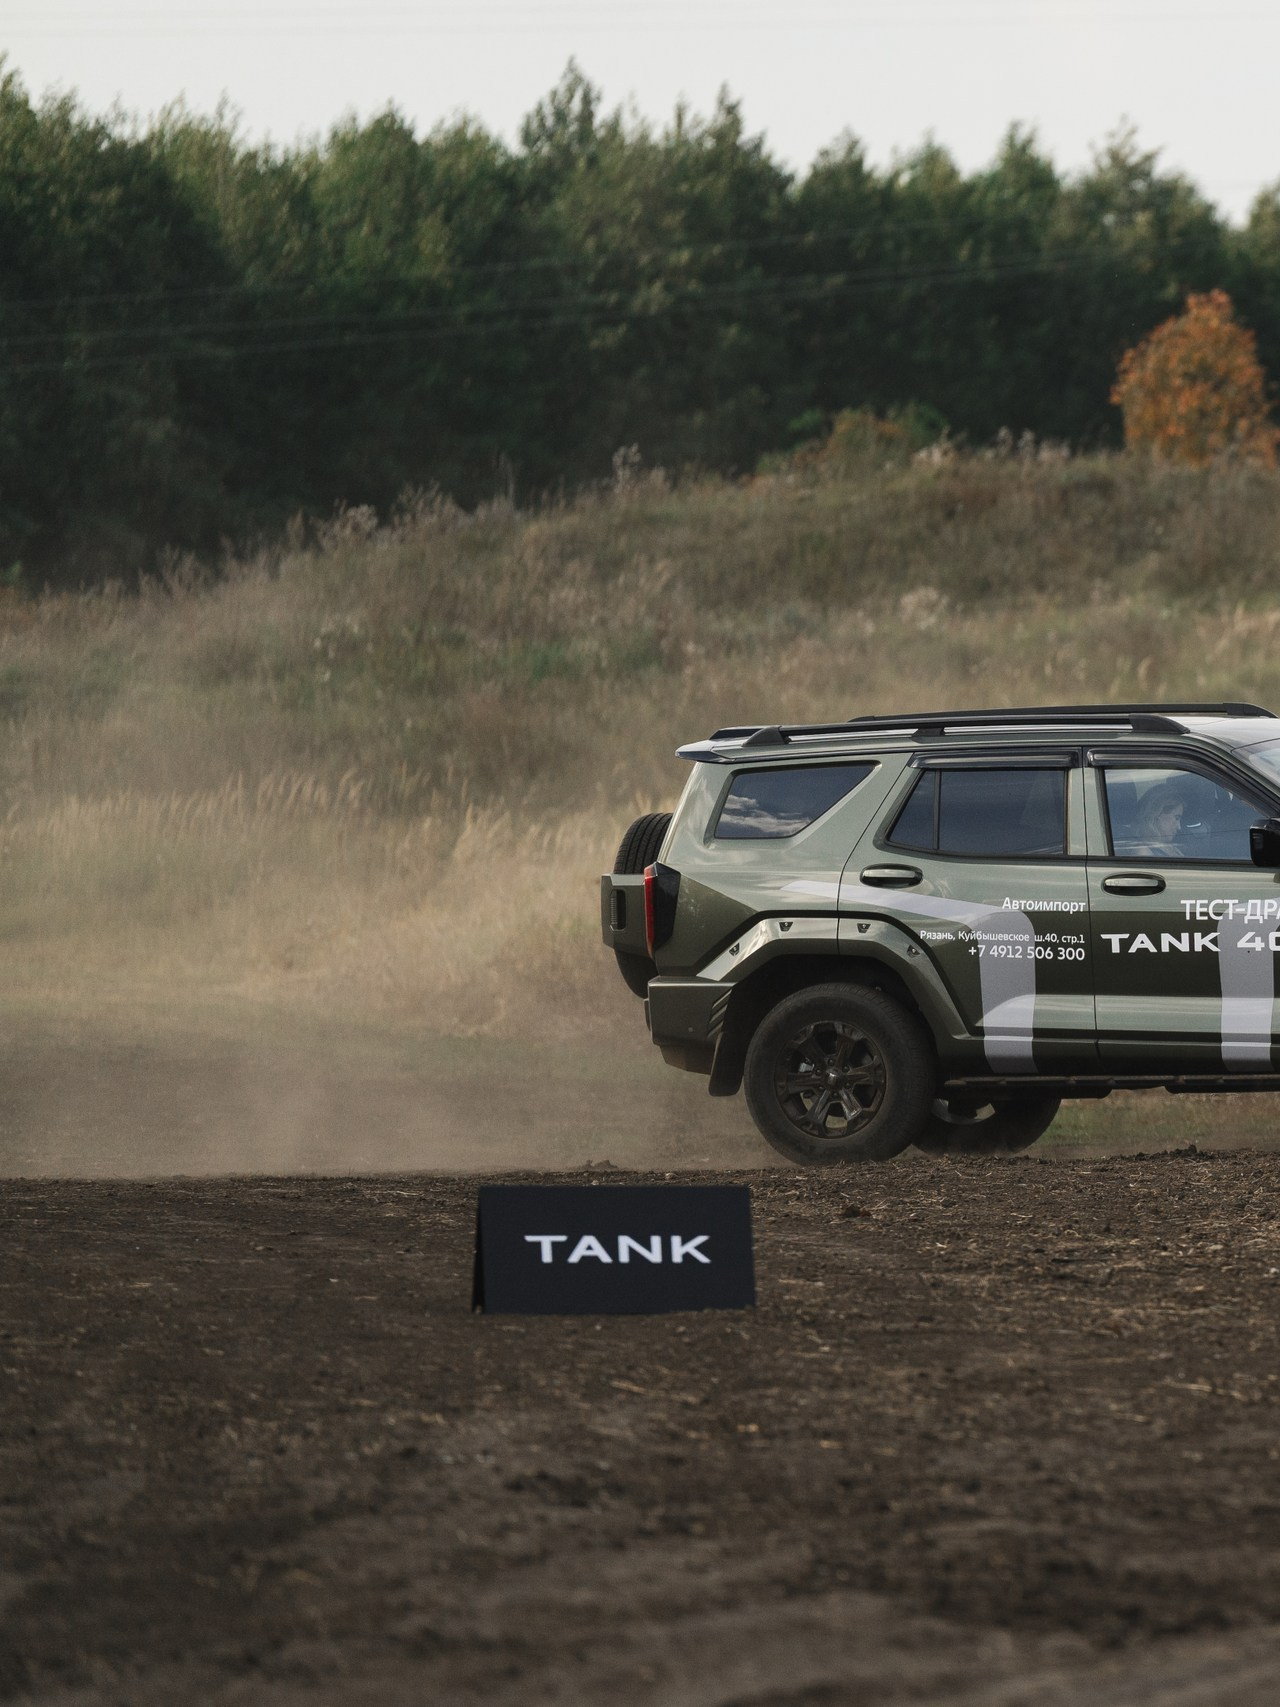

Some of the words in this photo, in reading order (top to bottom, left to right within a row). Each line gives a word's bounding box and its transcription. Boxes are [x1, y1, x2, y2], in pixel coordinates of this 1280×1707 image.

[1001, 897, 1086, 914] Автоимпорт
[919, 930, 955, 941] Рязань,
[958, 930, 1030, 942] Куйбышевское
[1061, 934, 1085, 944] стр.1
[1100, 932, 1221, 954] TANK
[968, 945, 986, 958] +7
[989, 945, 1023, 959] 4912
[1027, 946, 1054, 960] 506
[1057, 947, 1086, 961] 300
[524, 1235, 711, 1264] TANK
